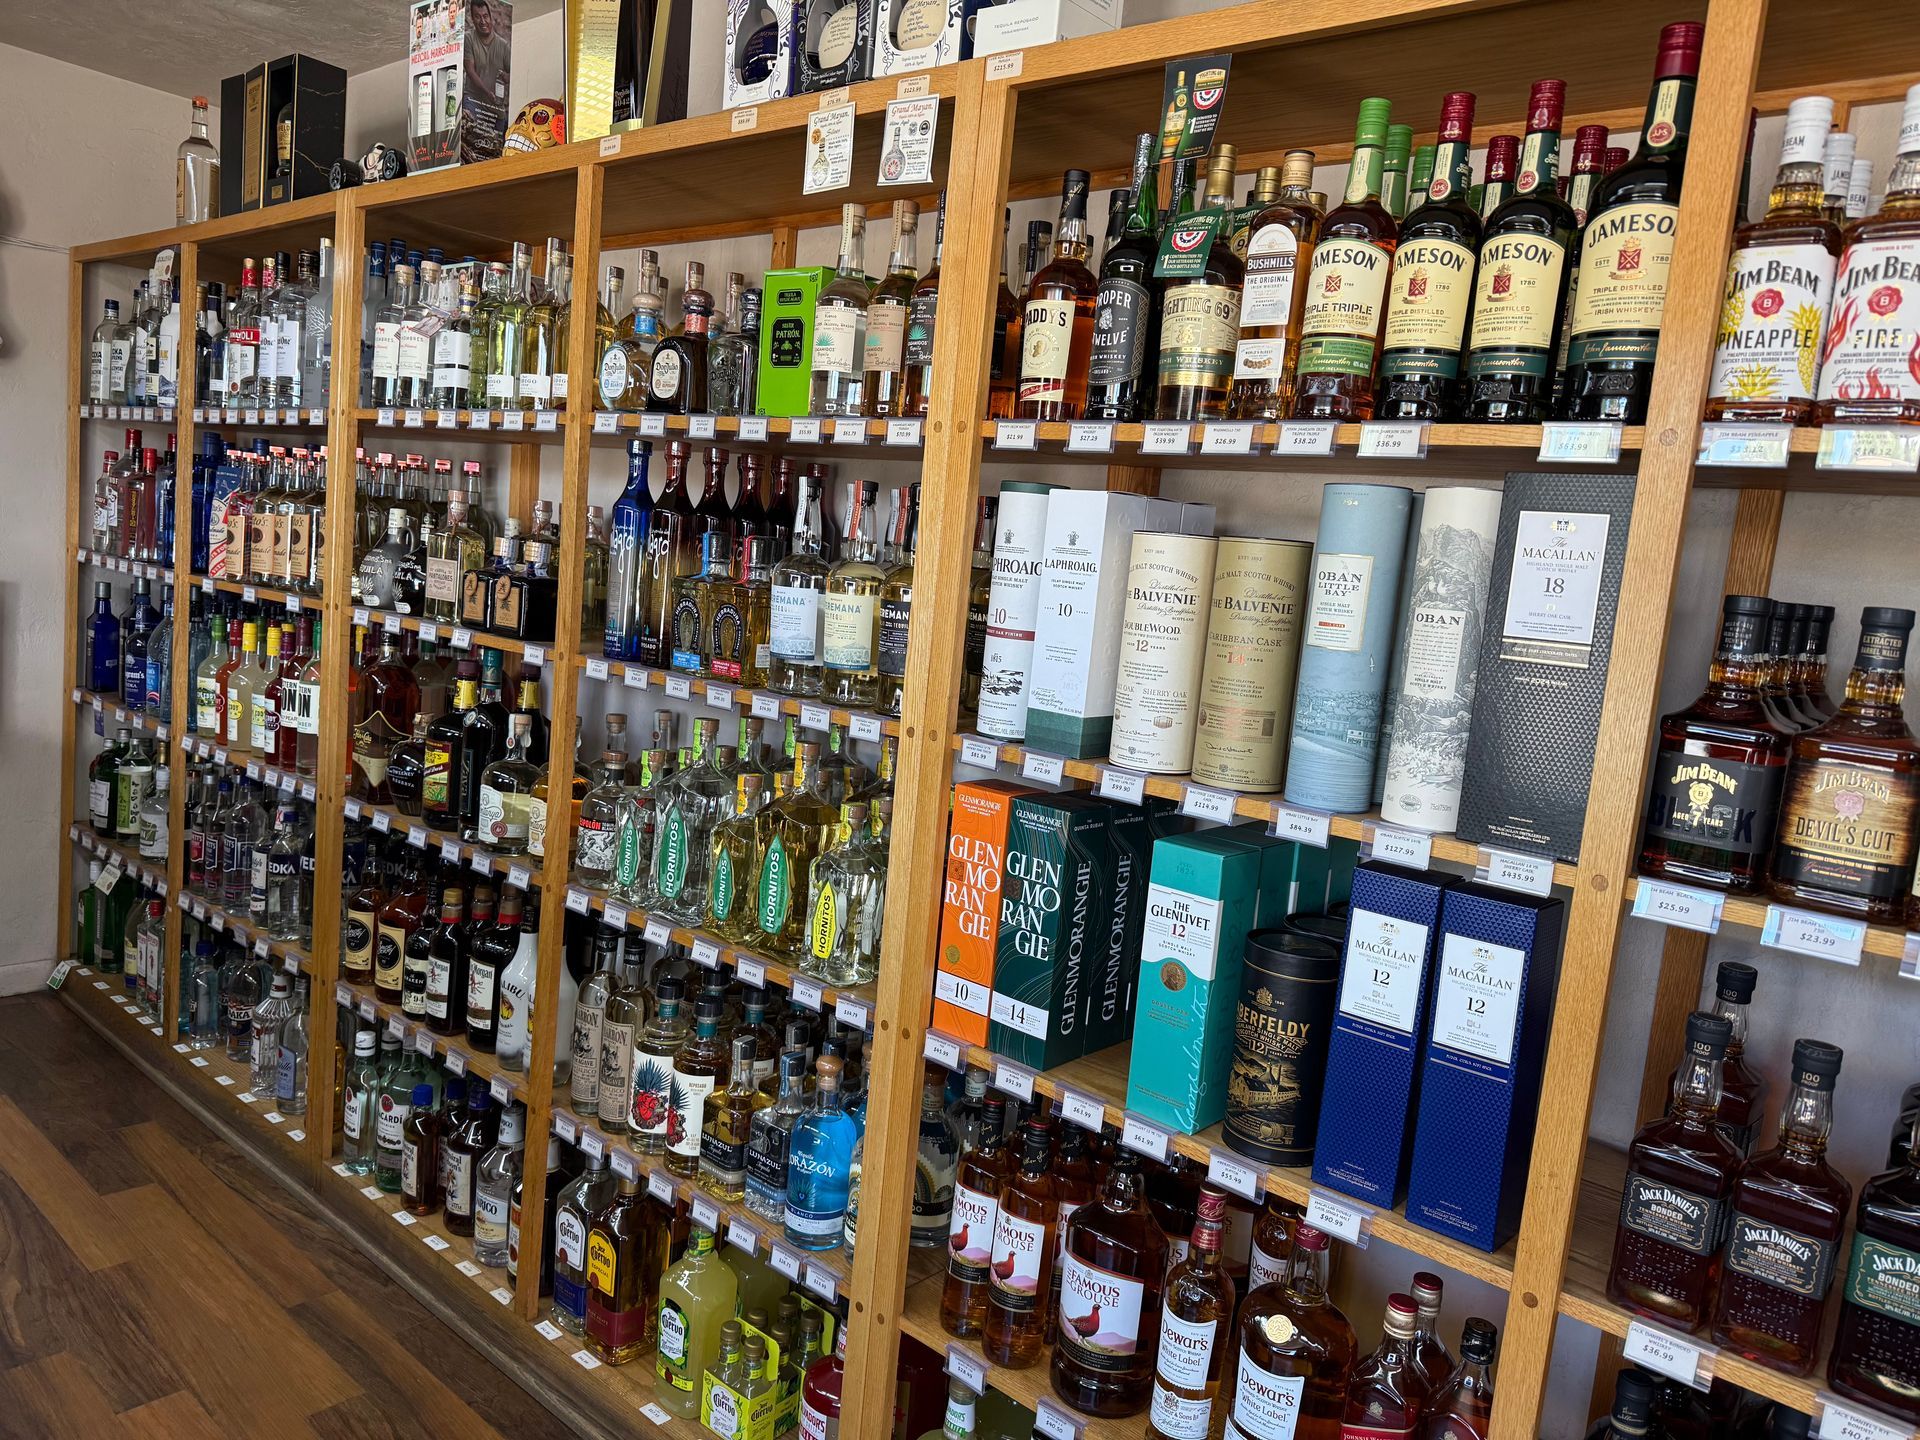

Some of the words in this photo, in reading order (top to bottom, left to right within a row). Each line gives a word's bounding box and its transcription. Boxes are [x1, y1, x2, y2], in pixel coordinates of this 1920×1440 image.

[411, 52, 429, 64] MEZCAL
[430, 44, 461, 61] MARGARITA
[994, 63, 1014, 72] $215.99
[814, 115, 829, 127] Grand
[891, 106, 907, 117] Grand
[1247, 257, 1295, 270] BUSHMILLS
[1593, 285, 1618, 295] TRIPLE
[1620, 284, 1663, 294] DISTILLED
[1729, 266, 1765, 300] JIM
[1766, 260, 1820, 295] BEAM
[1841, 266, 1879, 299] JIM
[1595, 308, 1611, 316] IRISH
[776, 327, 800, 339] PATRÓN
[1717, 329, 1812, 350] PINEAPPLE
[1854, 328, 1900, 348] FIRE
[1522, 548, 1596, 561] MACALLAN
[1044, 558, 1097, 573] LAPHROAIG
[1244, 571, 1271, 581] SCOTCH
[1273, 577, 1295, 591] WHISKY
[1318, 571, 1363, 583] OBAN
[1318, 582, 1359, 591] LITTLE
[1543, 578, 1565, 594] 18
[1133, 588, 1197, 606] BALVENIE
[1224, 597, 1293, 615] BALVENIE
[994, 608, 1007, 624] 10
[1058, 603, 1073, 617] 10
[1416, 613, 1462, 626] OBAN
[1136, 640, 1148, 652] 12
[1863, 635, 1902, 648] EXTRACTED
[1142, 688, 1171, 697] SHERRY
[1671, 764, 1698, 784] JIM
[1699, 763, 1737, 794] BEAM
[1815, 771, 1846, 793] JIM
[1848, 770, 1890, 804] BEAM
[1111, 784, 1130, 793] $59.90
[959, 794, 1001, 811] GLENMORANGIE
[1194, 801, 1219, 812] $114.99
[1016, 809, 1062, 828] GLENMORANGIE
[1289, 823, 1312, 833] $84.39
[1673, 812, 1689, 820] AGED
[1692, 810, 1701, 826] 7
[1704, 816, 1723, 827] YEARS
[1796, 817, 1856, 845] DEVIL'S
[1861, 829, 1895, 851] CUT
[623, 828, 632, 881] HORNITOS
[666, 820, 679, 893] HORNITOS
[950, 835, 1001, 868] GLEN
[1384, 844, 1414, 856] $127.99
[964, 862, 1001, 892] MO
[1006, 851, 1061, 888] GLEN
[1501, 870, 1535, 884] $435.99
[718, 859, 728, 915] HORNITOS
[765, 851, 780, 928] HORNITOS
[1020, 880, 1060, 911] MO
[945, 881, 986, 914] RAN
[1173, 900, 1190, 912] THE
[1001, 898, 1044, 934] RAN
[1657, 901, 1690, 914] $25.99
[819, 895, 832, 954] HORNITOS
[959, 911, 991, 940] GIE
[1151, 904, 1210, 931] GLENLIVET
[1101, 853, 1131, 1021] GLENMORANGIE
[1171, 923, 1186, 938] 12
[1800, 931, 1836, 947] $23.99
[1014, 929, 1050, 961] GIE
[1060, 860, 1091, 1036] GLENMORANGIE
[1355, 939, 1416, 964] MACALLAN
[1372, 969, 1391, 986] 12
[1447, 966, 1513, 990] MACALLAN
[954, 981, 968, 1001] 10
[1010, 1004, 1026, 1025] 14
[1466, 996, 1485, 1015] 12
[1250, 1041, 1264, 1054] 12
[1257, 1026, 1281, 1041] SINGLE
[1283, 1039, 1300, 1051] MALT
[1693, 1041, 1711, 1052] 100
[1693, 1048, 1710, 1056] PROOF
[1801, 1078, 1819, 1087] PROOF
[1802, 1071, 1820, 1083] 100
[701, 1132, 733, 1153] LUNAZUL
[1134, 1135, 1154, 1147] $61.99
[749, 1150, 781, 1170] LUNAZUL
[1220, 1171, 1242, 1185] $55.49
[1640, 1188, 1663, 1201] JACK
[1663, 1189, 1700, 1219] DANIEL'S
[1651, 1204, 1683, 1220] BONDED
[1319, 1214, 1344, 1227] $90.99
[559, 1223, 580, 1244] Cuervo
[1744, 1228, 1769, 1242] JACK
[1770, 1229, 1811, 1261] DANIEL'S
[1757, 1245, 1792, 1262] BONDED
[590, 1248, 610, 1267] Cuervo
[1071, 1269, 1120, 1297] FAMOUS
[1878, 1273, 1919, 1293] BONDED
[1070, 1282, 1119, 1308] GROUSE
[662, 1316, 683, 1337] Cuervo
[1162, 1319, 1208, 1351] Dewar's
[1631, 1326, 1646, 1335] JACK
[1647, 1331, 1668, 1346] DANIEL'S
[1669, 1341, 1691, 1354] BONDED
[1642, 1344, 1674, 1362] $36.99
[1240, 1367, 1295, 1407] Dewar's
[713, 1396, 735, 1416] Cuervo
[1242, 1394, 1261, 1411] White
[1262, 1407, 1286, 1422] Label
[1832, 1408, 1847, 1418] JACK
[1045, 1419, 1063, 1434] $40.50
